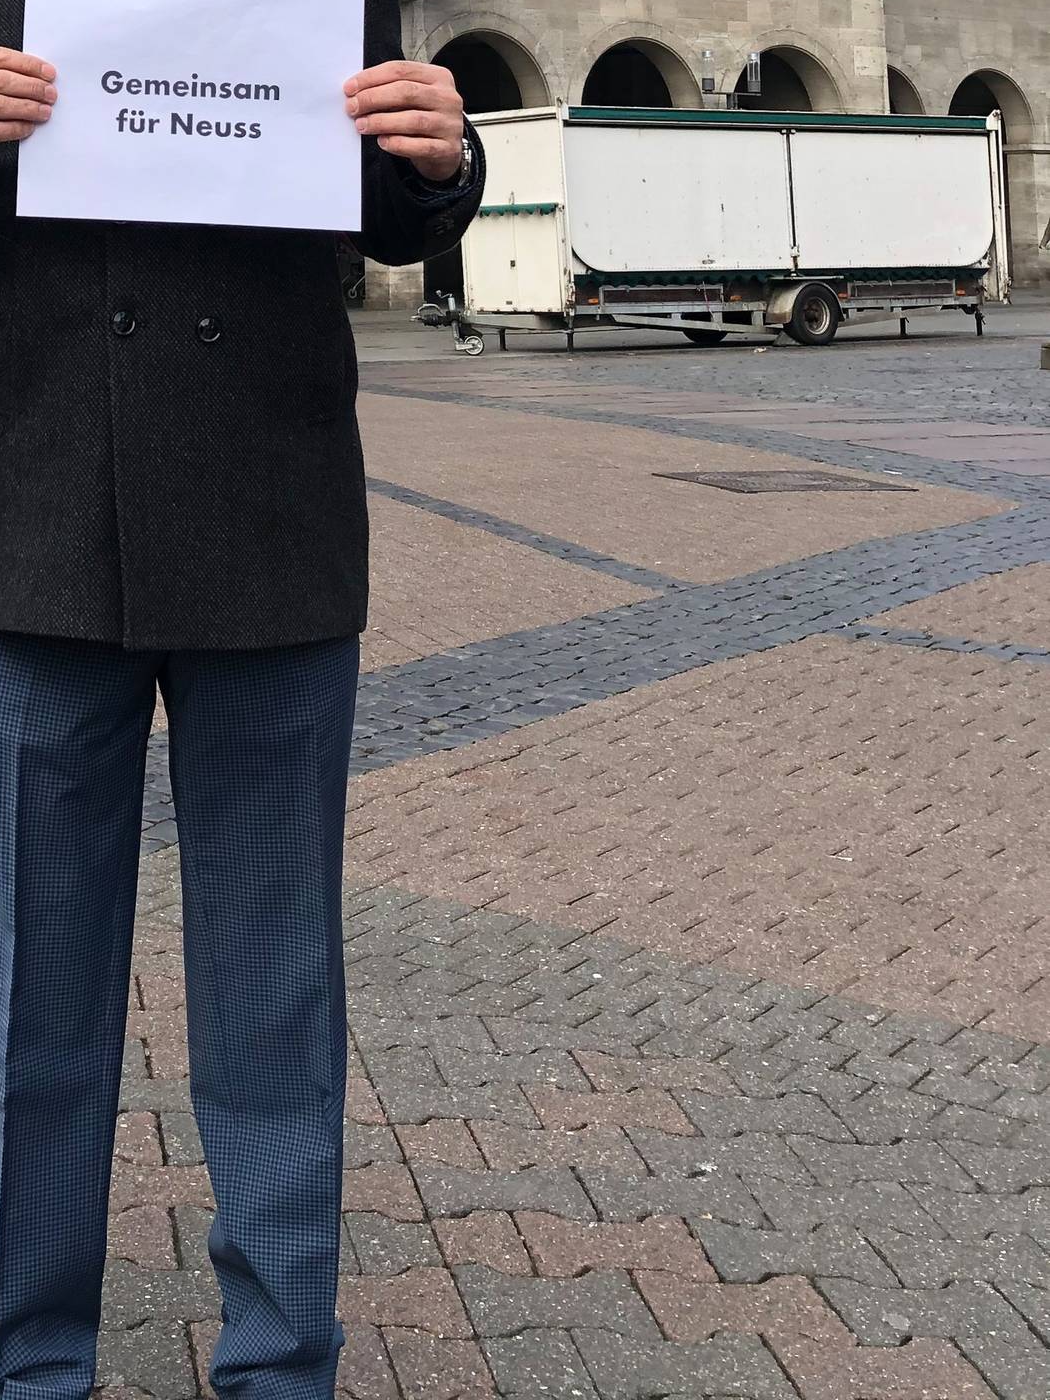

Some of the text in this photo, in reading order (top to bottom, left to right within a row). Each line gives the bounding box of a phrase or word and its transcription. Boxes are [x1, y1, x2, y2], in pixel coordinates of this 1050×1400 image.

[100, 70, 280, 101] Gemeinsam
[115, 107, 262, 139] für Neuss
